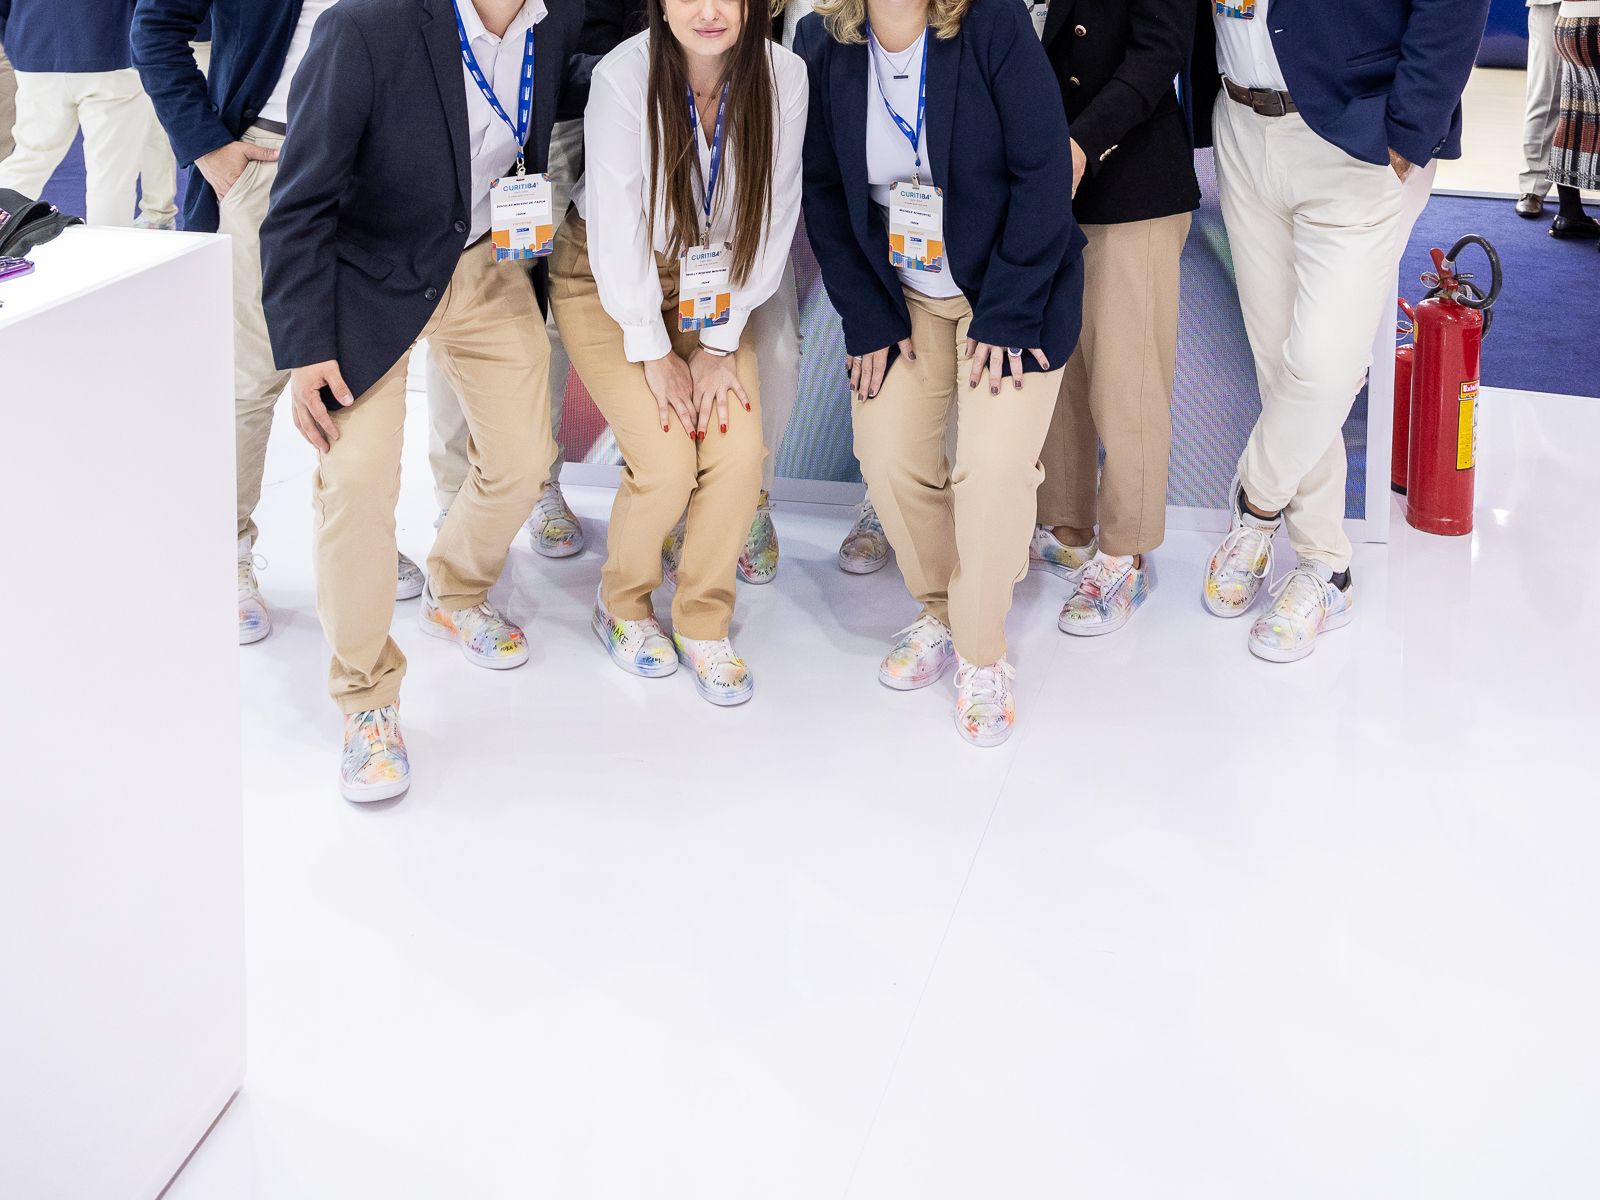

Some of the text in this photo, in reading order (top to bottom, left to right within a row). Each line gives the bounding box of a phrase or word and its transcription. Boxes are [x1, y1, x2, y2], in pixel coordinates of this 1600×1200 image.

[503, 183, 537, 193] CURITIBA
[900, 190, 930, 201] CURITIBA
[691, 251, 720, 261] CURITIBA
